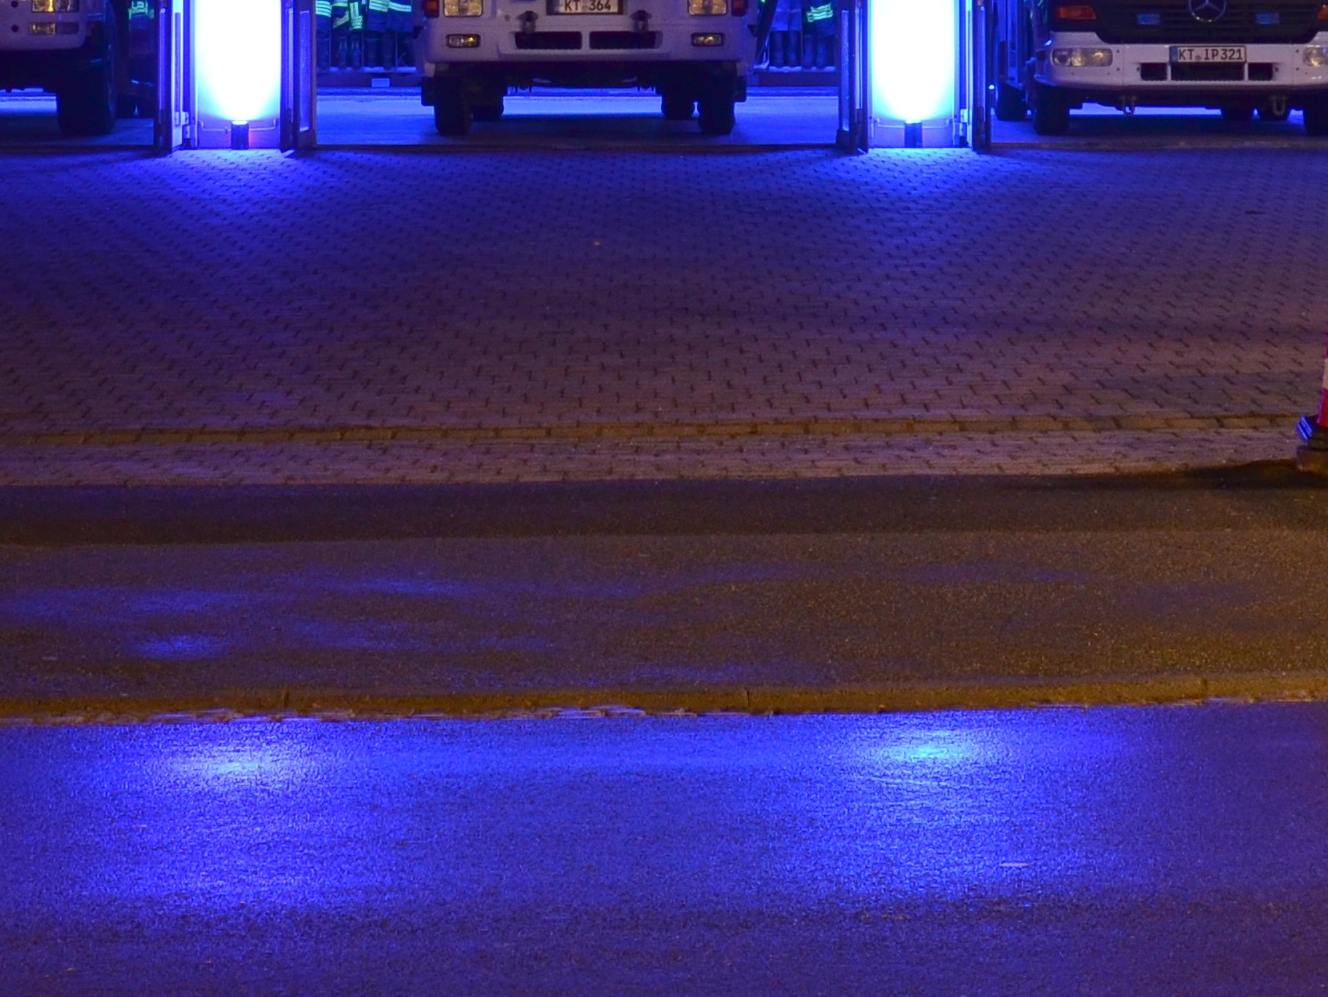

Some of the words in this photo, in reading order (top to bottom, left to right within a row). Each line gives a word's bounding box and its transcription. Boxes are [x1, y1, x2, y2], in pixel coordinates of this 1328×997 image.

[564, 0, 580, 11] KT
[588, 0, 612, 11] 364
[1178, 49, 1195, 60] KT
